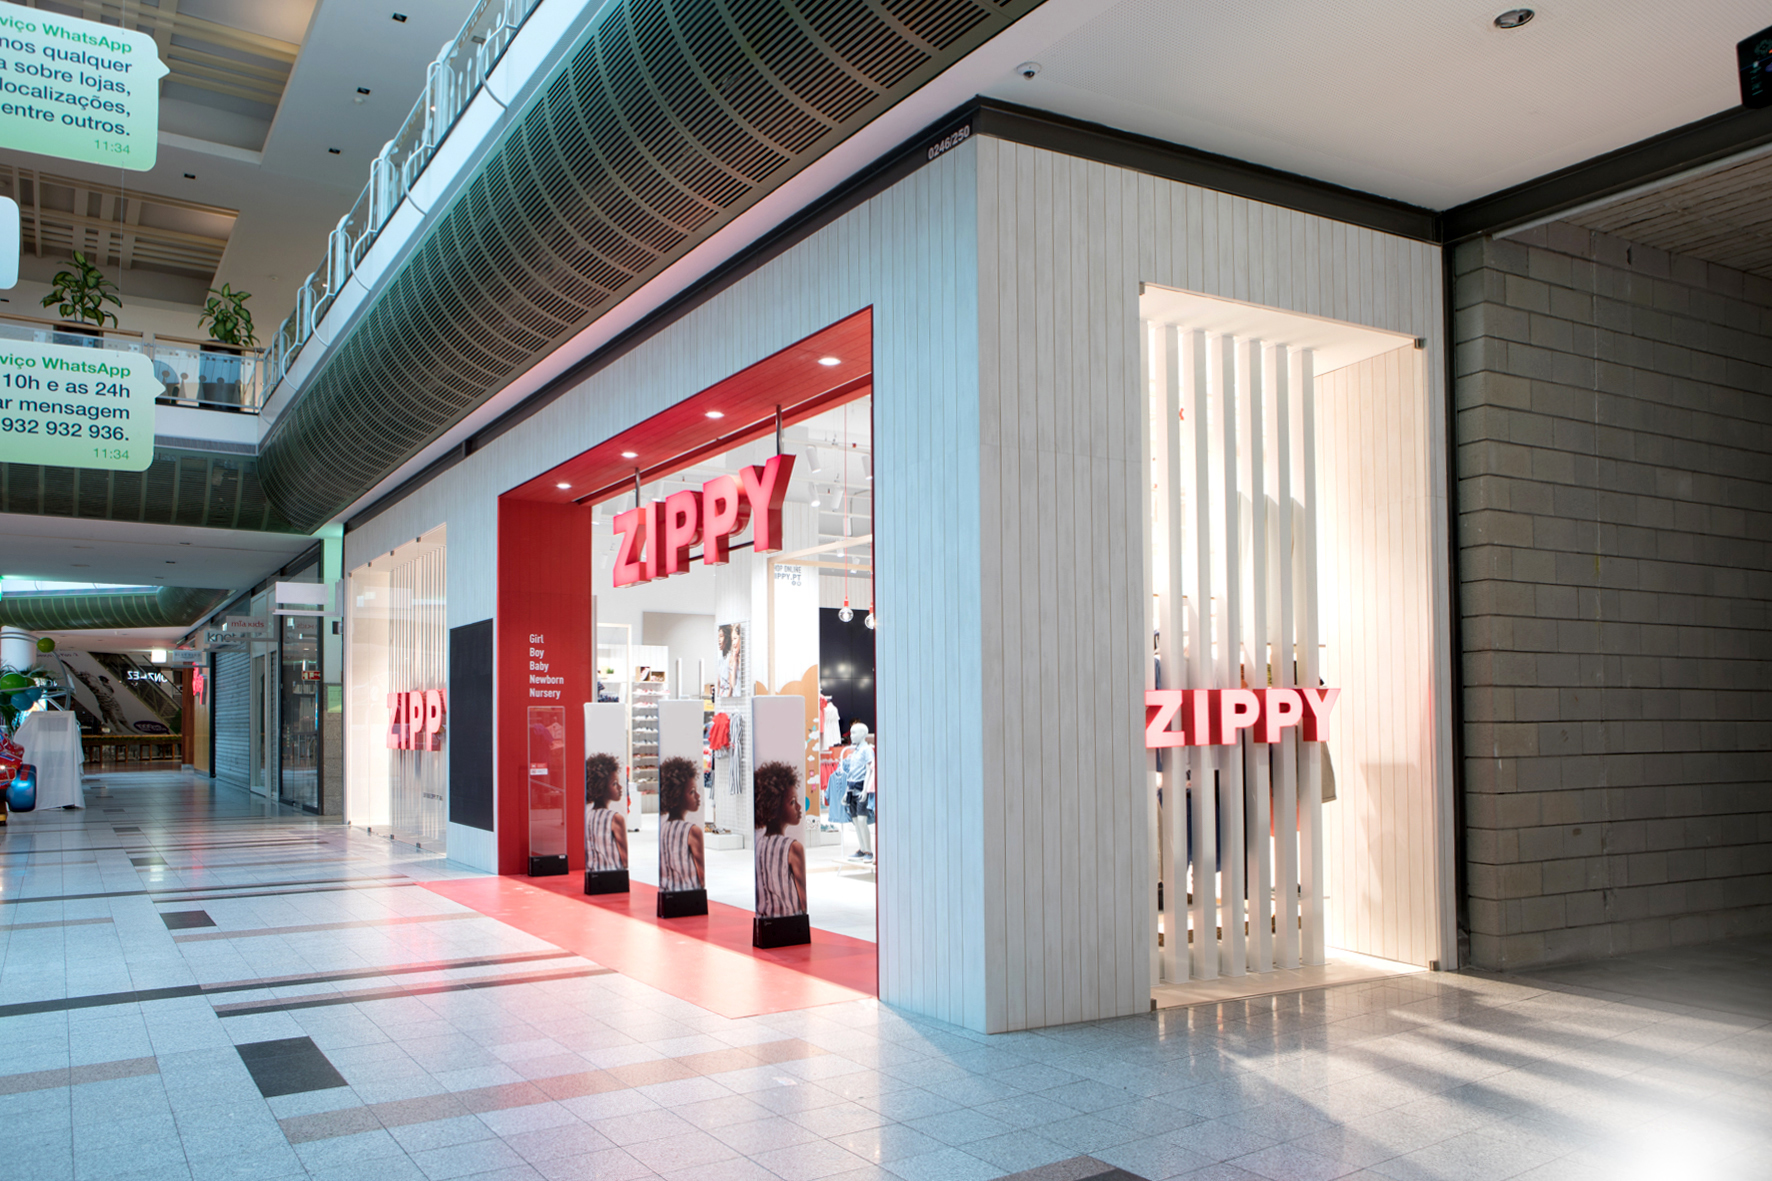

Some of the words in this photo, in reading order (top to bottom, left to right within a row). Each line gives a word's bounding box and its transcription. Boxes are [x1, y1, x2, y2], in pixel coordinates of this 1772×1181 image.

[42, 22, 132, 54] WhatsApp
[42, 46, 132, 73] qualquer
[14, 63, 73, 83] sobre
[80, 71, 131, 97] lojas,
[1, 102, 55, 122] entre
[61, 113, 130, 136] outros.
[94, 139, 130, 154] 11:34
[928, 125, 970, 160] 0246/250
[42, 356, 131, 379] WhatsApp
[3, 373, 40, 390] 10h
[46, 380, 59, 391] e
[65, 382, 89, 394] as
[95, 382, 130, 398] 24h
[19, 399, 130, 420] mensagem
[1, 417, 39, 434] 932
[45, 421, 82, 437] 932
[88, 424, 130, 441] 936.
[93, 448, 129, 460] 11:34
[613, 454, 790, 588] ZIPPY
[529, 634, 544, 644] Girl
[529, 647, 544, 659] Boy
[529, 661, 549, 673] Baby
[529, 674, 564, 684] Newborn
[529, 688, 561, 700] Nursery
[1145, 688, 1341, 748] ZIPPY
